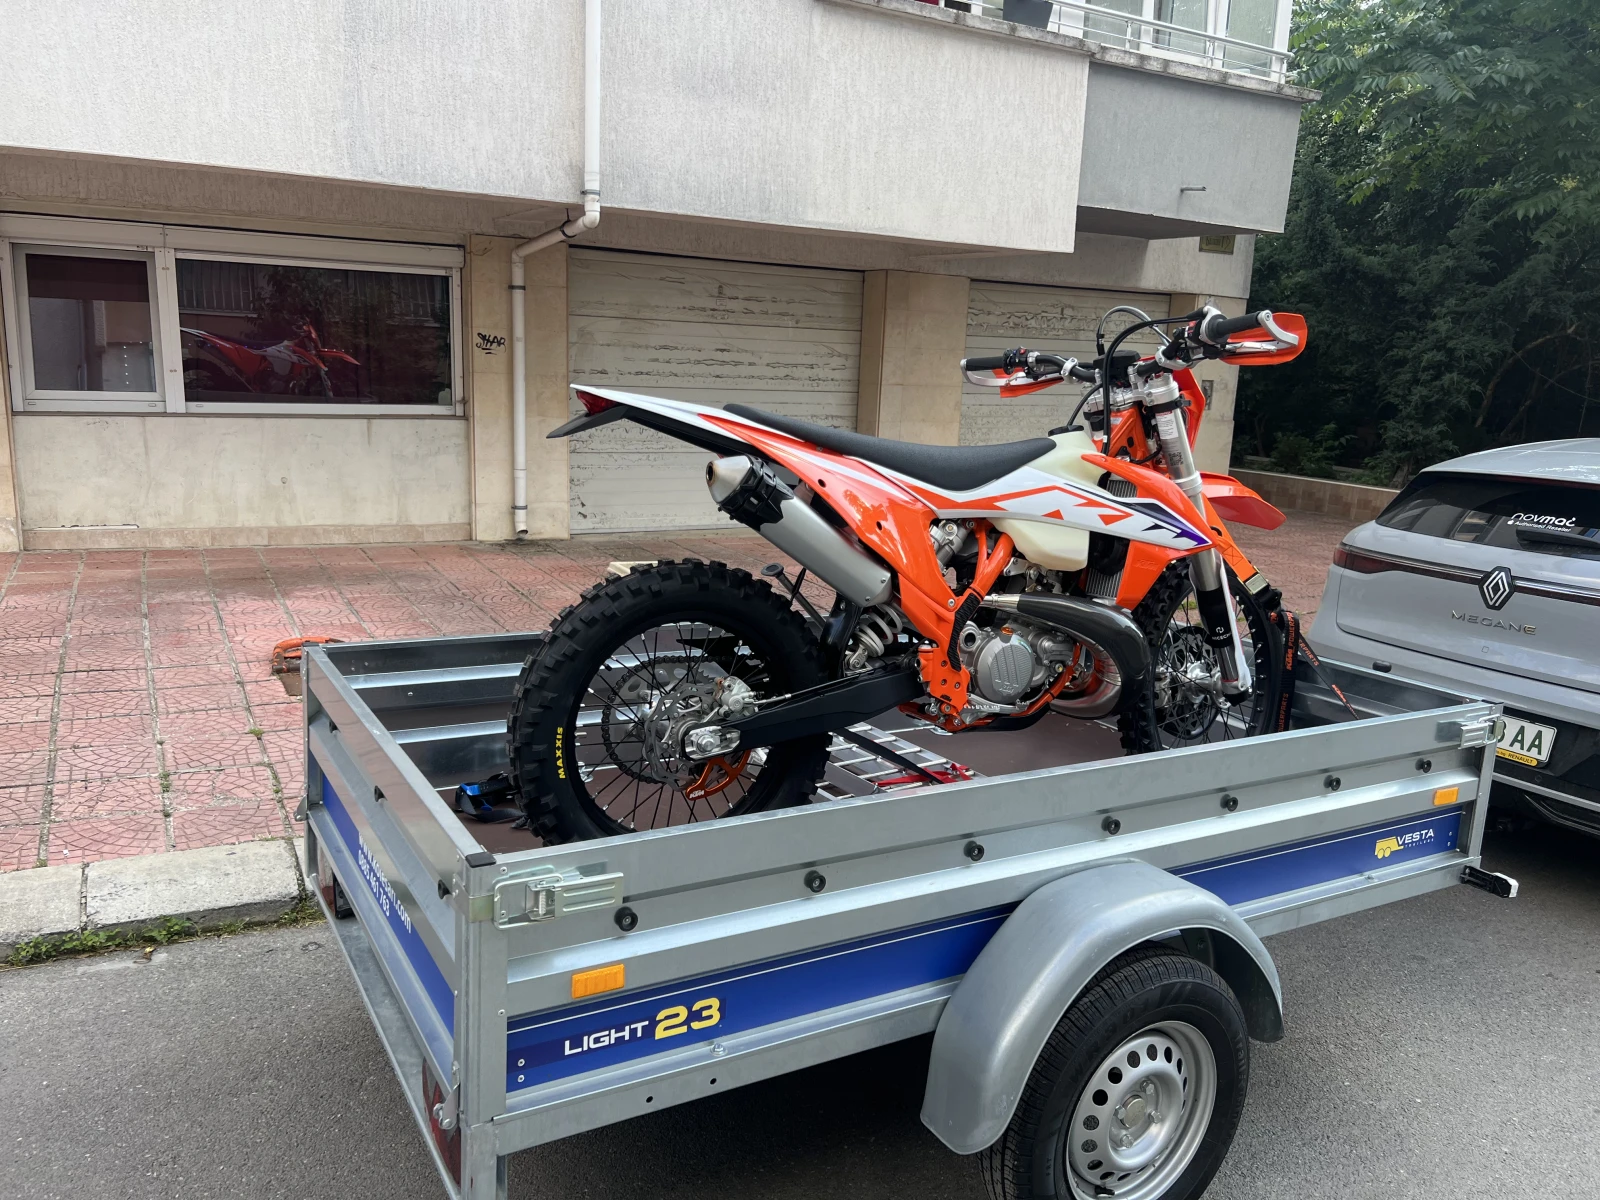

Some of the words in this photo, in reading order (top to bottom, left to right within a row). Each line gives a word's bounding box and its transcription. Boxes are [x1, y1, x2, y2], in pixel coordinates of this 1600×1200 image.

[1511, 512, 1576, 527] novmac
[1451, 610, 1537, 636] MEGANE
[555, 726, 566, 779] MAXXIS
[1507, 752, 1533, 764] RENAULT
[689, 790, 705, 799] KTM
[1397, 828, 1435, 845] VESTA
[379, 887, 390, 917] 763
[564, 1020, 650, 1056] LIGHT
[654, 997, 721, 1041] 23
